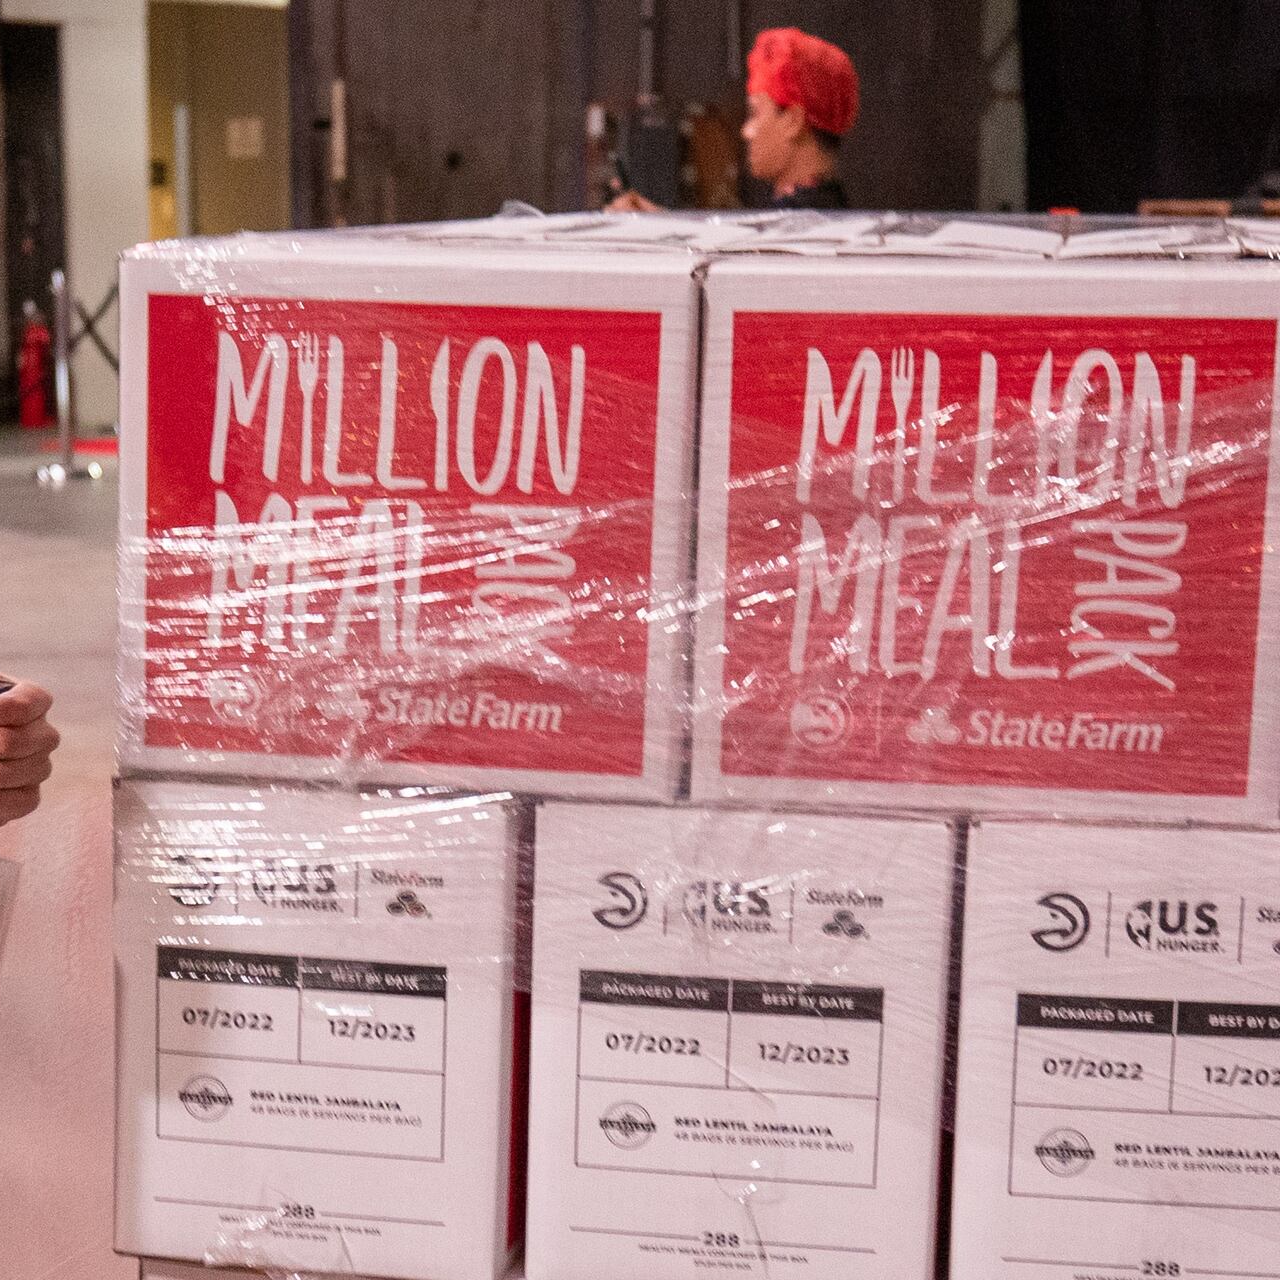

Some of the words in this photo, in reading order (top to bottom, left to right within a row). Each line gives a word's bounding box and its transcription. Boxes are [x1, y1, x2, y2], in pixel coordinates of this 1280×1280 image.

[209, 330, 586, 496] MILLION
[795, 346, 1196, 509] MILLION
[789, 511, 1063, 684] MEAL
[1066, 518, 1189, 693] PACK
[676, 987, 711, 1002] DATE
[761, 992, 797, 1007] BEST
[798, 994, 817, 1009] BY
[818, 996, 856, 1011] DATE
[182, 1004, 274, 1033] 07/2022
[327, 1016, 416, 1044] 12/2023
[1118, 1010, 1155, 1025] DATE
[1208, 1013, 1245, 1028] BEST
[1246, 1015, 1267, 1029] BY
[604, 1029, 702, 1058] 07/2022
[757, 1040, 850, 1068] 12/2023
[1042, 1054, 1144, 1082] 07/2022
[702, 1230, 740, 1248] 288
[1141, 1259, 1181, 1277] 288
